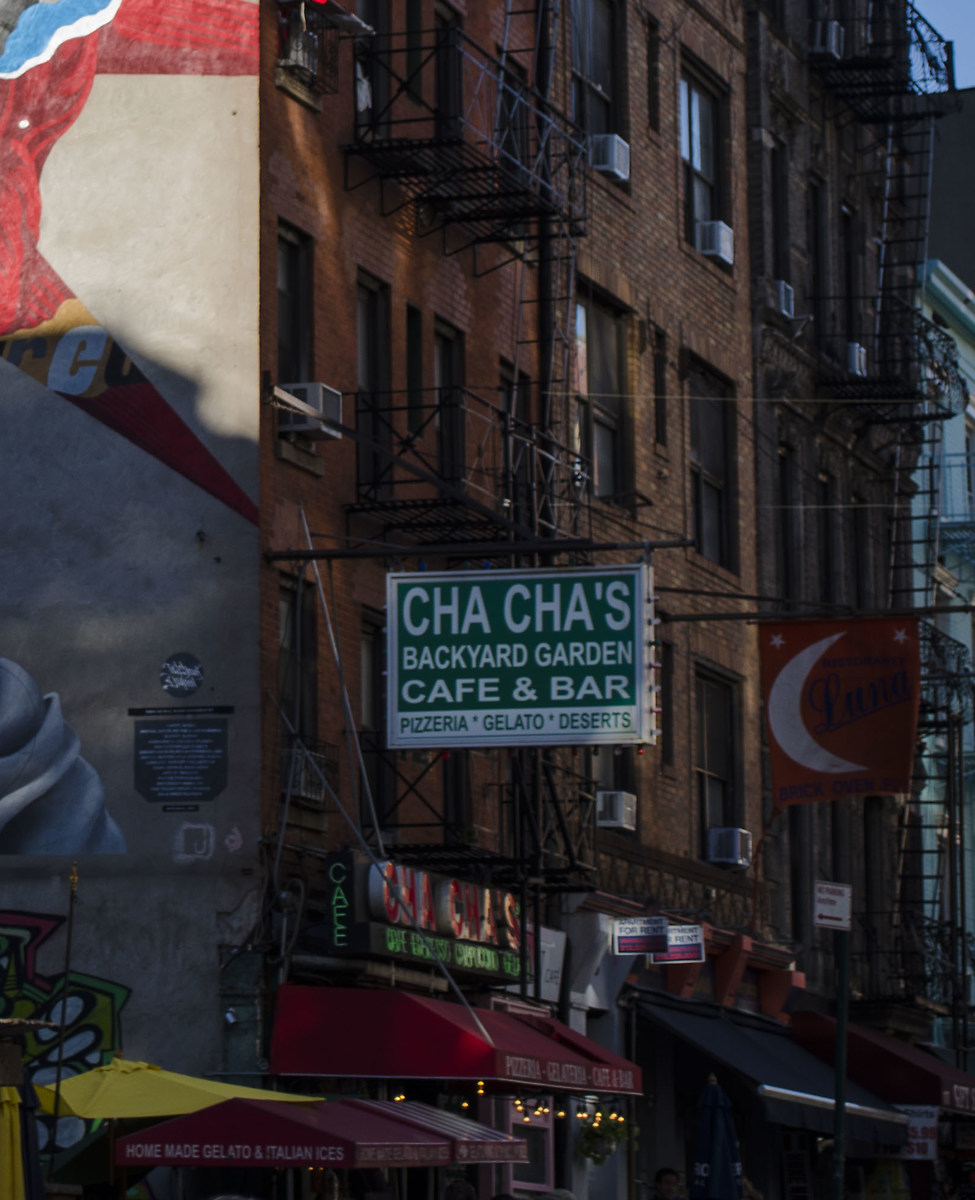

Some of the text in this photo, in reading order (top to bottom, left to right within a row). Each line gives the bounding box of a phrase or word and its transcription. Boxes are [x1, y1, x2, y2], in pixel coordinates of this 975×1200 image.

[402, 580, 632, 637] CHA CHA'S
[402, 640, 633, 670] BACKYARD GARDEN
[401, 674, 632, 704] CAFE & BAR
[807, 669, 914, 735] Luna
[400, 712, 632, 735] PIZZERIA GELATO DESERTS
[779, 781, 825, 802] BRICK
[832, 777, 875, 795] OVEN
[329, 862, 349, 947] CAFE
[382, 861, 521, 951] CHA CHA'S
[619, 926, 665, 935] FOR RENT
[675, 935, 699, 943] RENT
[505, 1055, 542, 1080] PIZZERIA
[547, 1061, 588, 1086] GELATERIA
[125, 1143, 163, 1159] HOME
[164, 1143, 200, 1159] MADE
[202, 1144, 251, 1160] GELATO
[254, 1145, 264, 1160] &
[265, 1144, 313, 1161] ITALIAN
[316, 1145, 345, 1162] ICES
